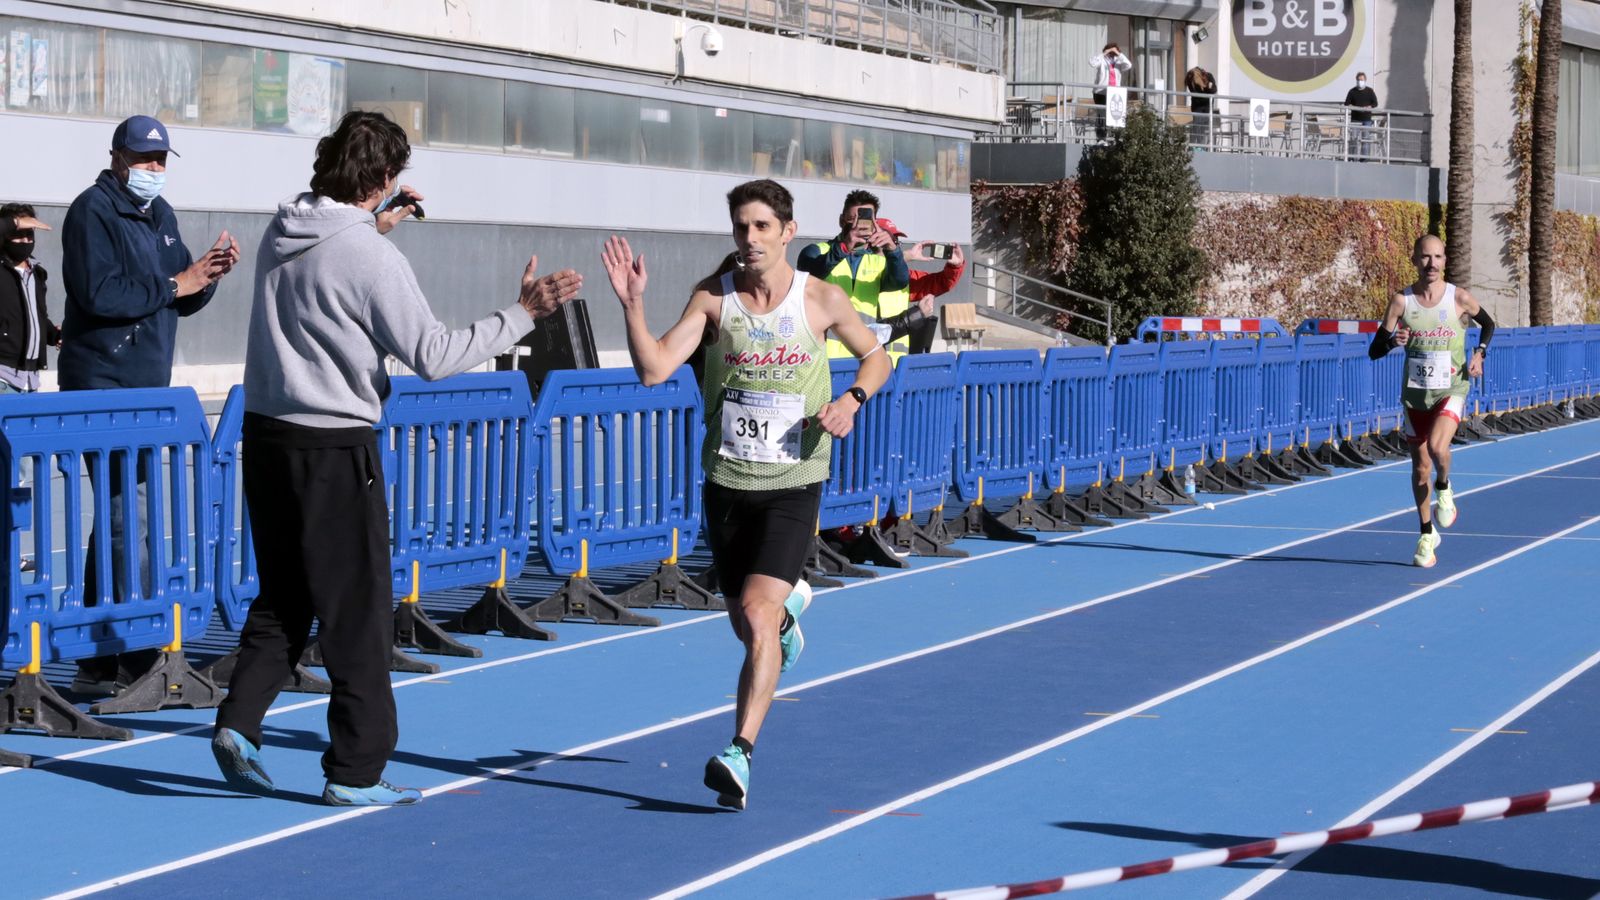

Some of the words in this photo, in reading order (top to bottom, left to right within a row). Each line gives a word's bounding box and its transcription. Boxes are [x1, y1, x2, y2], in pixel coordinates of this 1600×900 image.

[1244, 0, 1347, 36] B&B
[1258, 41, 1331, 56] HOTELS
[724, 344, 811, 367] maratón
[735, 368, 794, 380] JEREZ
[1416, 365, 1434, 377] 362
[726, 390, 739, 400] XXV
[744, 407, 779, 416] ANTONIO
[736, 417, 769, 441] 391
